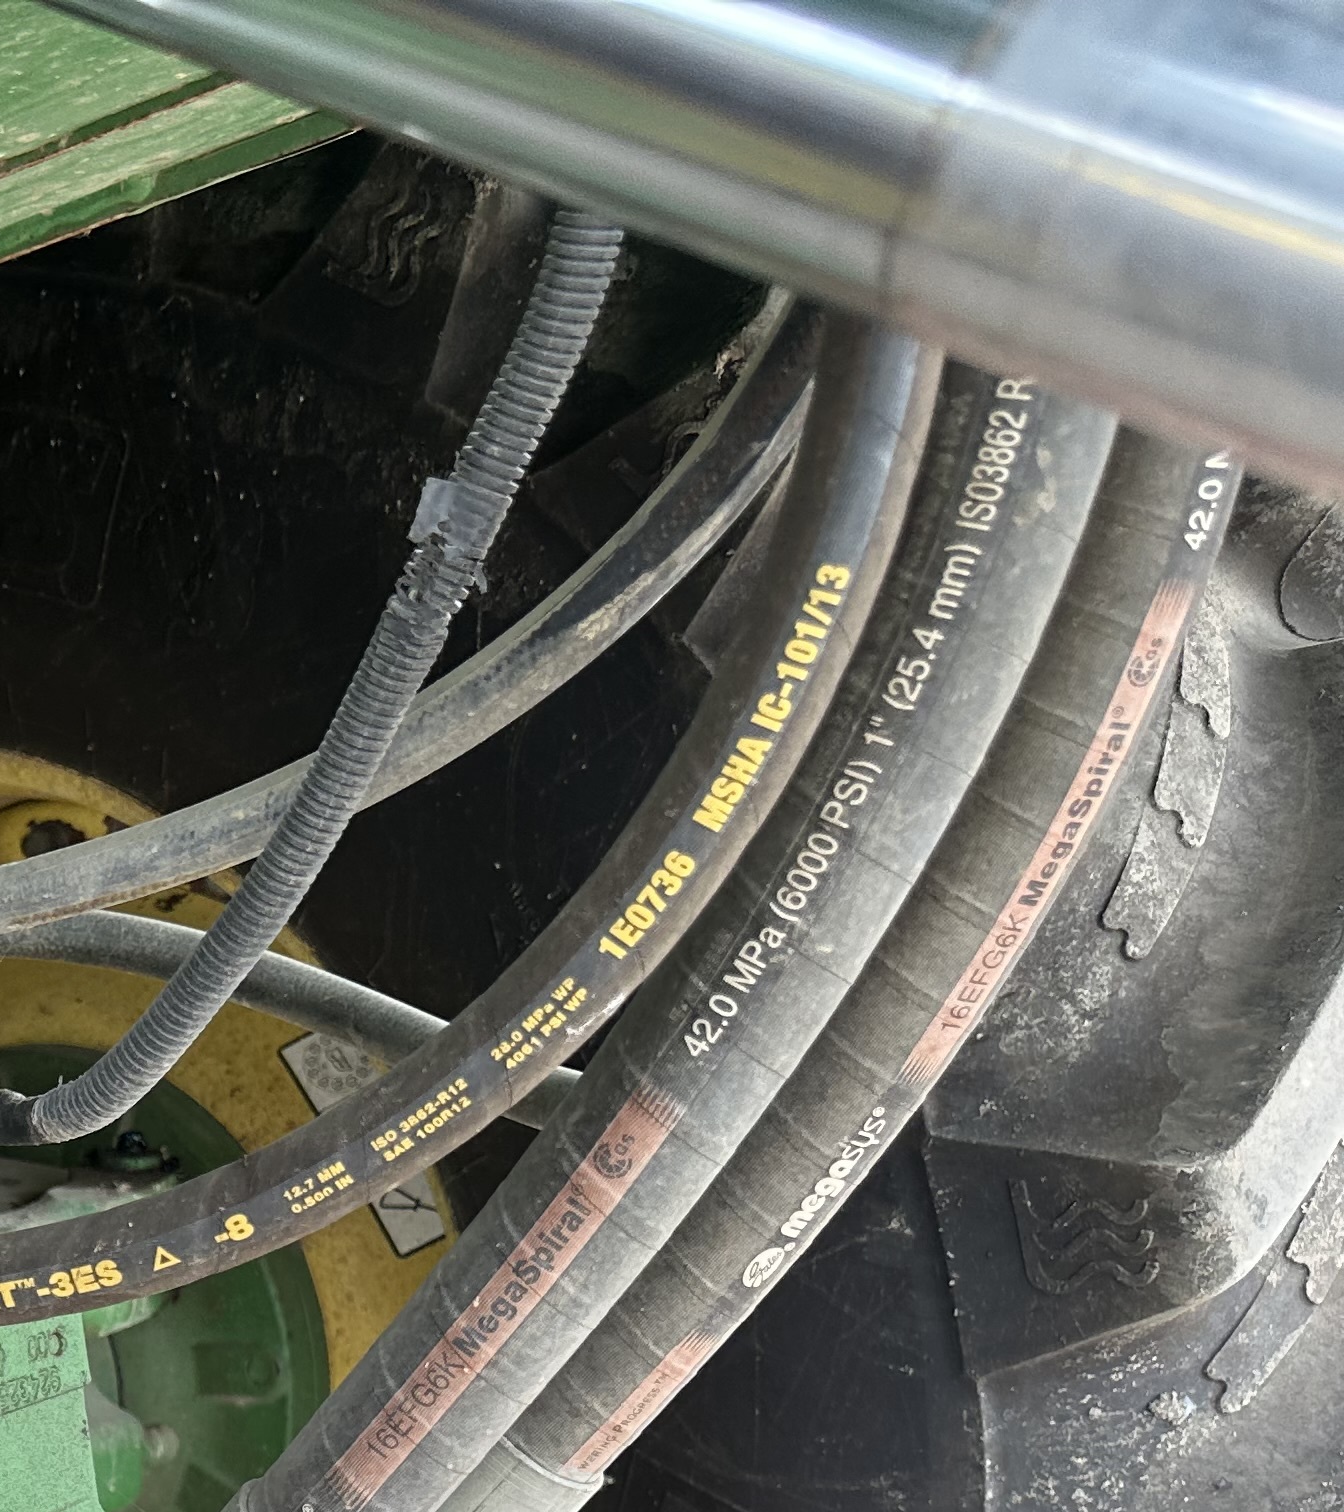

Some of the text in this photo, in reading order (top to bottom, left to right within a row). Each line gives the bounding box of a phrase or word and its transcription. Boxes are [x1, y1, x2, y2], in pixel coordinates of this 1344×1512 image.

[1184, 478, 1224, 551] 42.0
[692, 563, 851, 833] MSHA IC-101/13
[684, 994, 739, 1057] 42.0
[723, 926, 786, 993] MPa
[769, 832, 839, 923] (6000
[819, 760, 882, 829] PSI)
[882, 626, 945, 711] (25.4
[928, 542, 984, 620] mm)
[598, 850, 696, 960] 1E0736
[940, 913, 1030, 1031] 16EFG6K
[490, 976, 575, 1061] 28.0 MPa WP
[505, 986, 588, 1069] 4061 PSI WP
[370, 1077, 469, 1151] ISO 3862-R12
[382, 1096, 473, 1162] SAE 100R12
[282, 1160, 346, 1202] 12.7 MM
[334, 1174, 355, 1191] IN
[365, 1348, 470, 1463] 16EFG6K
